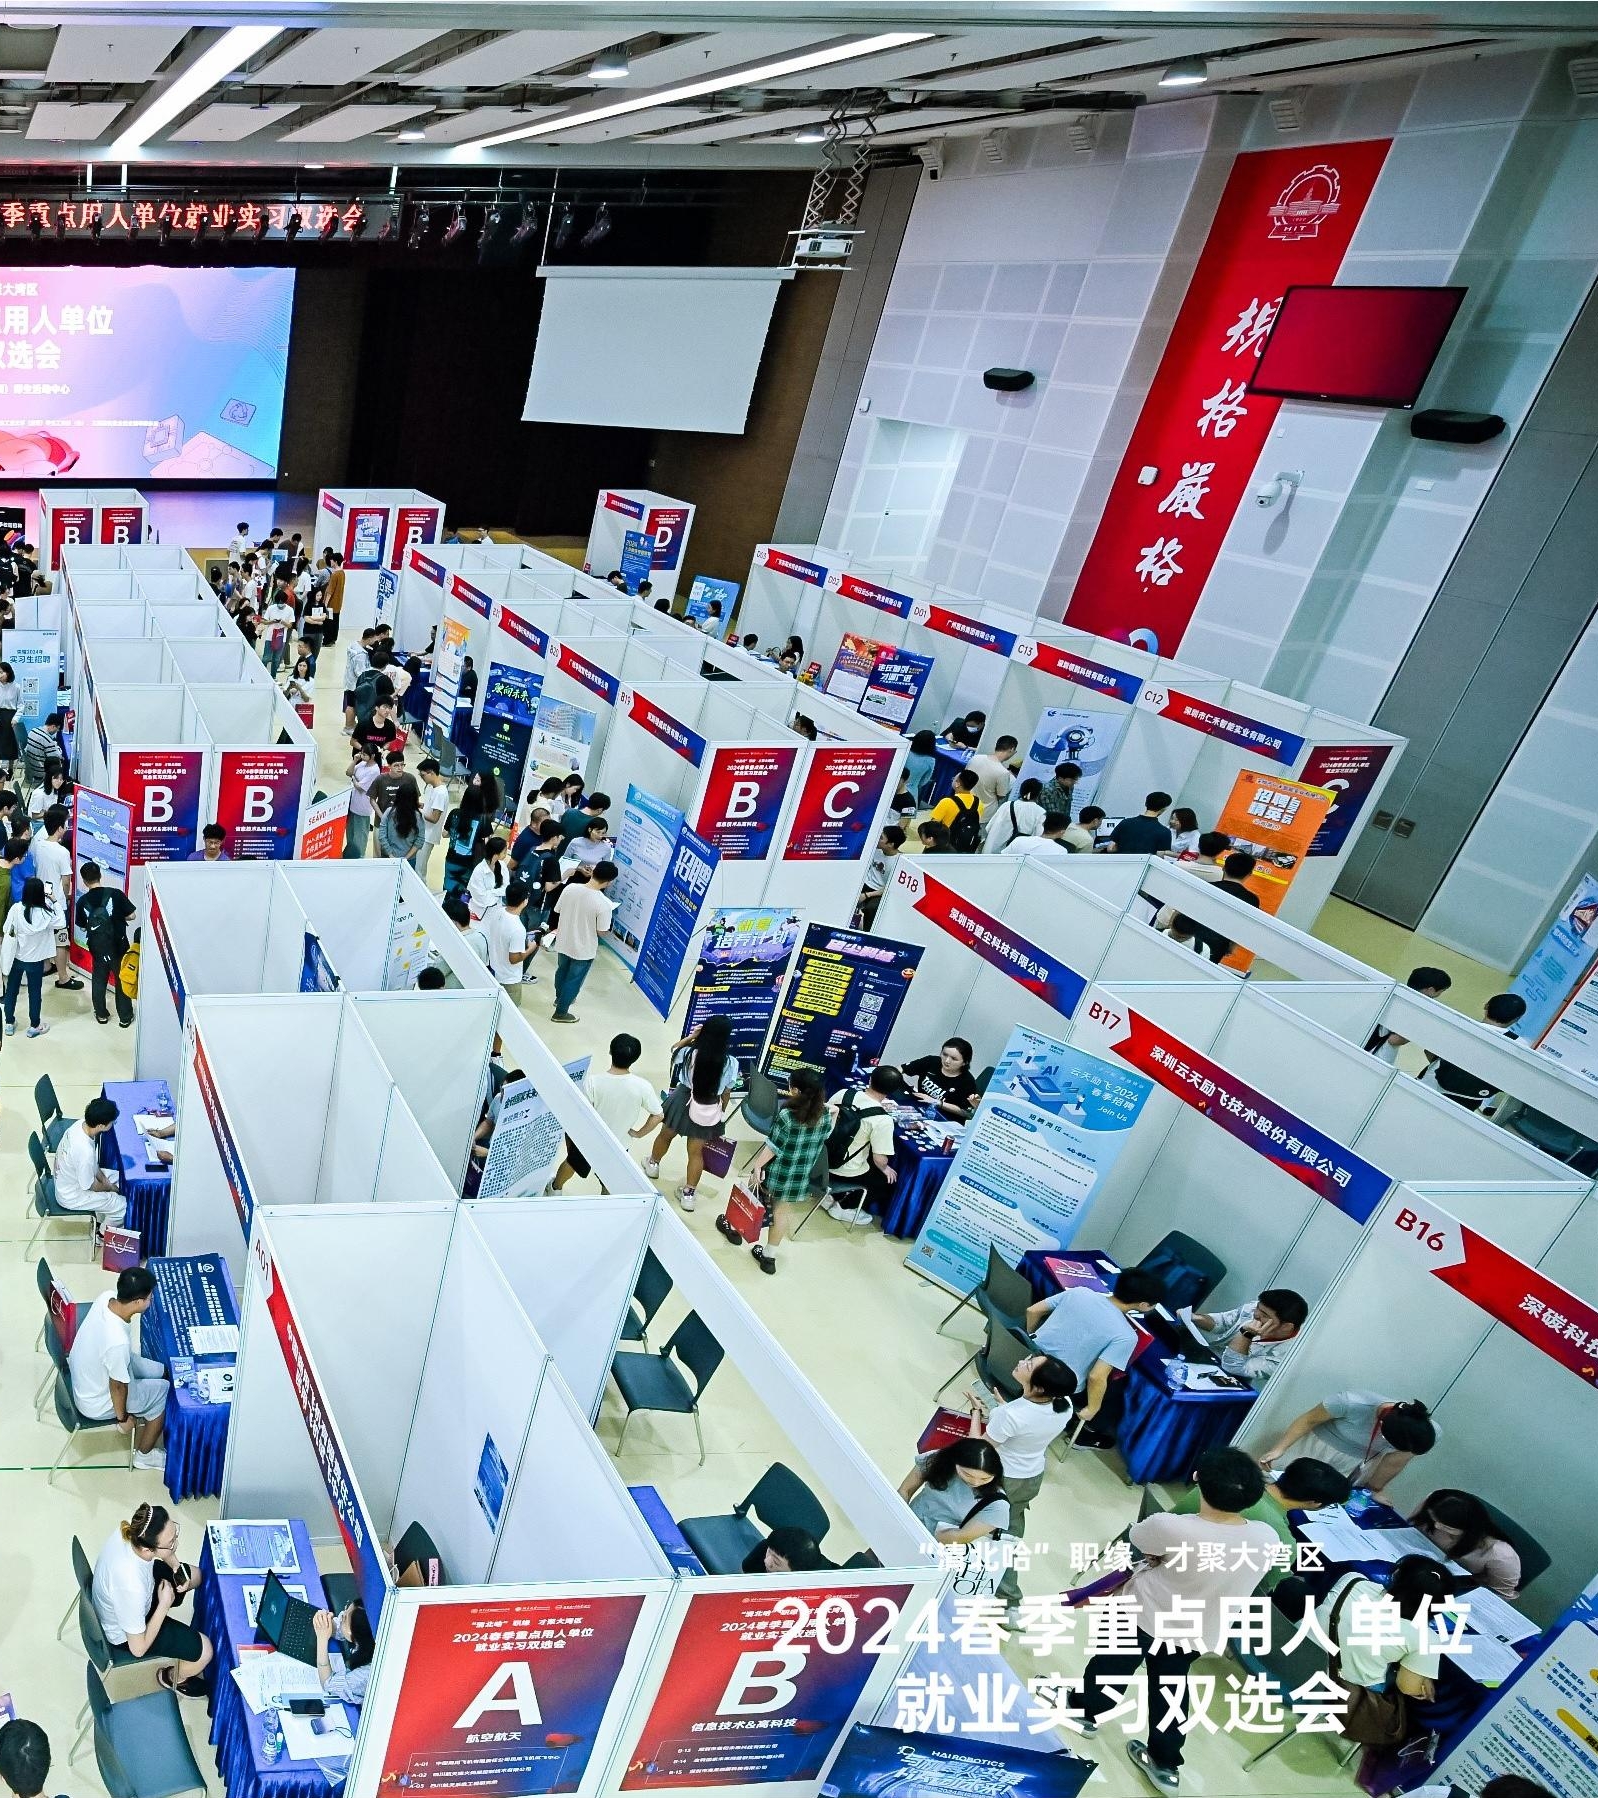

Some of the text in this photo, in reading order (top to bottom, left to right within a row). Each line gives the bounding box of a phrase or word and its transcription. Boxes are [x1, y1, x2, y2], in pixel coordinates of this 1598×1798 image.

[64, 526, 81, 545] B
[113, 525, 130, 545] B
[407, 526, 424, 544] B
[654, 526, 674, 548] D
[913, 606, 928, 619] D01
[1017, 642, 1034, 657] C13
[1144, 690, 1283, 751] C12 深圳市仁禾智能实业有限公司
[143, 785, 174, 823] B
[242, 785, 274, 823] B
[725, 781, 760, 819] B
[822, 780, 860, 819] C
[1254, 787, 1288, 810] 招聘
[898, 869, 1050, 984] B18 深圳市望尘科技有限公司
[1040, 1064, 1060, 1077] AI
[1069, 1066, 1140, 1103] 云天励飞 2024
[1088, 1000, 1353, 1189] B17 深圳云天励飞技术股份有限公司
[1090, 1087, 1136, 1113] 春季招聘
[1097, 1104, 1129, 1122] Join Us
[1394, 1206, 1446, 1254] B16
[253, 1234, 364, 1549] A01 中国商用飞机有限责任公司
[452, 1627, 595, 1644] 2024春季重点用人单位
[473, 1639, 567, 1653] 就业实习双选会
[451, 1661, 543, 1729] A
[714, 1650, 808, 1716] B
[690, 1717, 799, 1733] 信息技术&高科技
[465, 1731, 522, 1744] 航空航天
[1533, 1707, 1598, 1771] 材料研发工程师
[951, 1753, 1006, 1768] ROBOTICS
